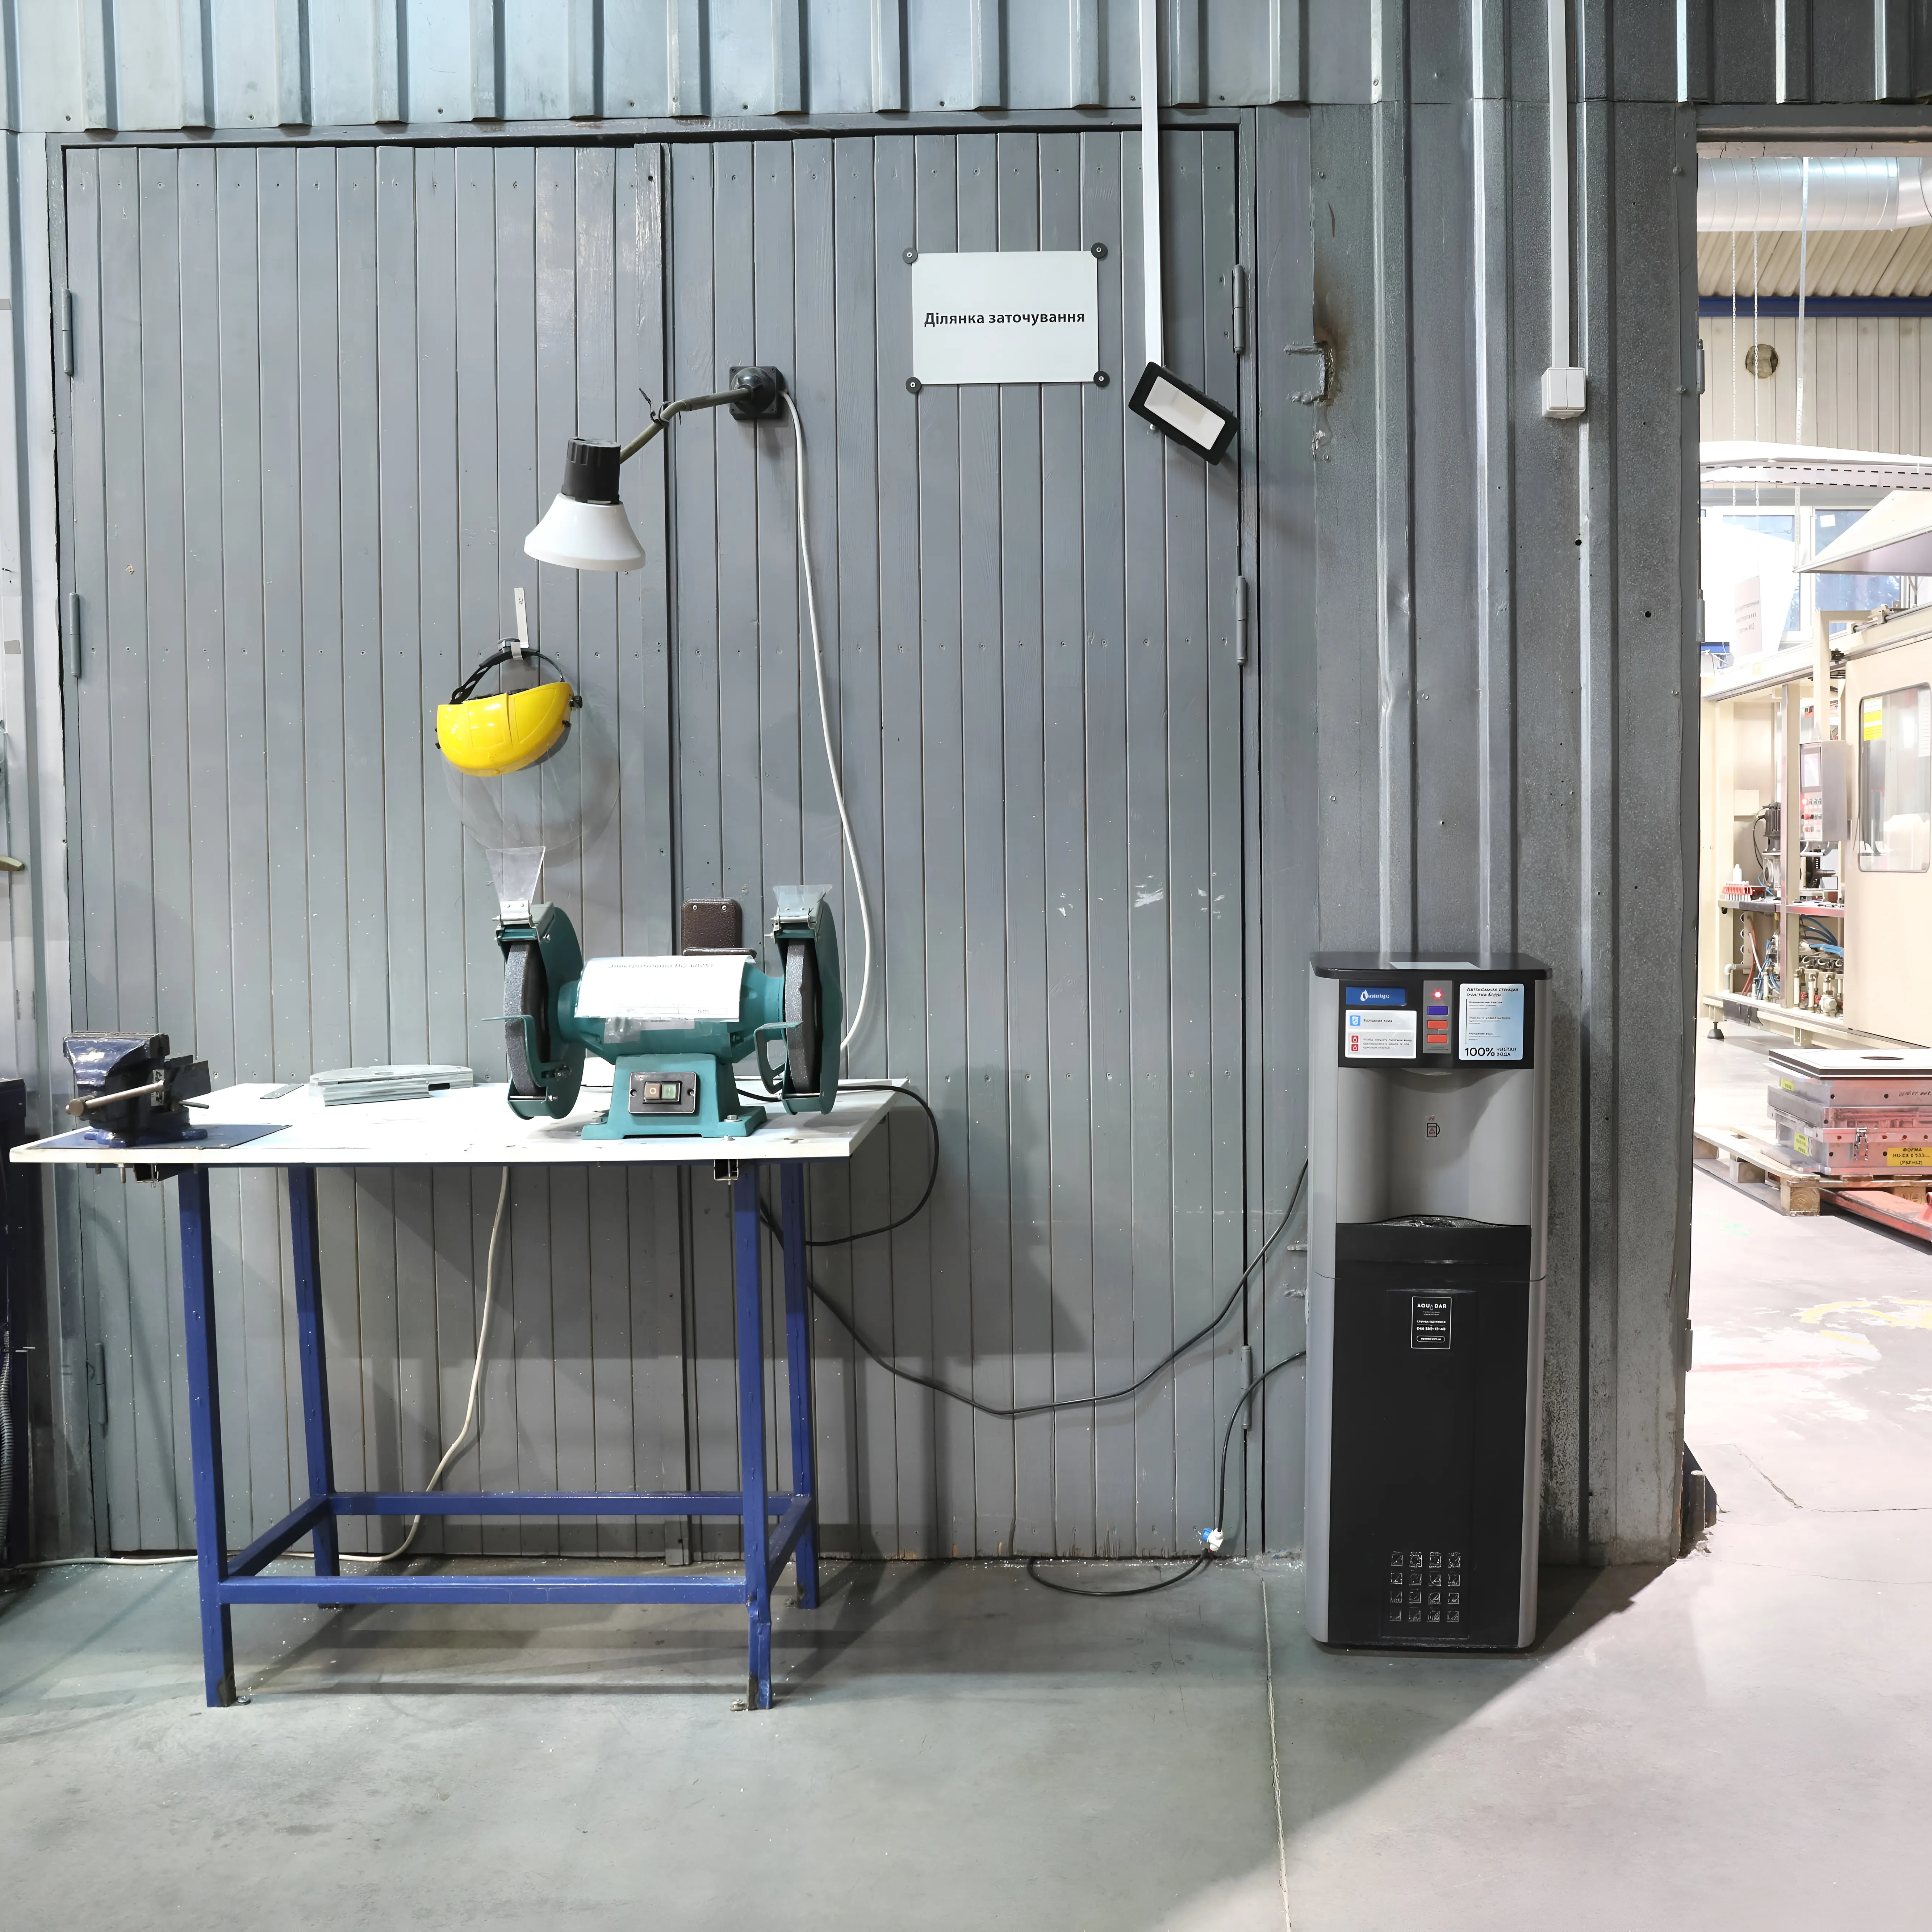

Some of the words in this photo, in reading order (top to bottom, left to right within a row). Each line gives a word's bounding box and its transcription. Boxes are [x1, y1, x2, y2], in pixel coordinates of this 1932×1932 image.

[924, 312, 984, 327] Ділянка
[988, 313, 1085, 326] заточування
[1465, 1047, 1495, 1056] 100%
